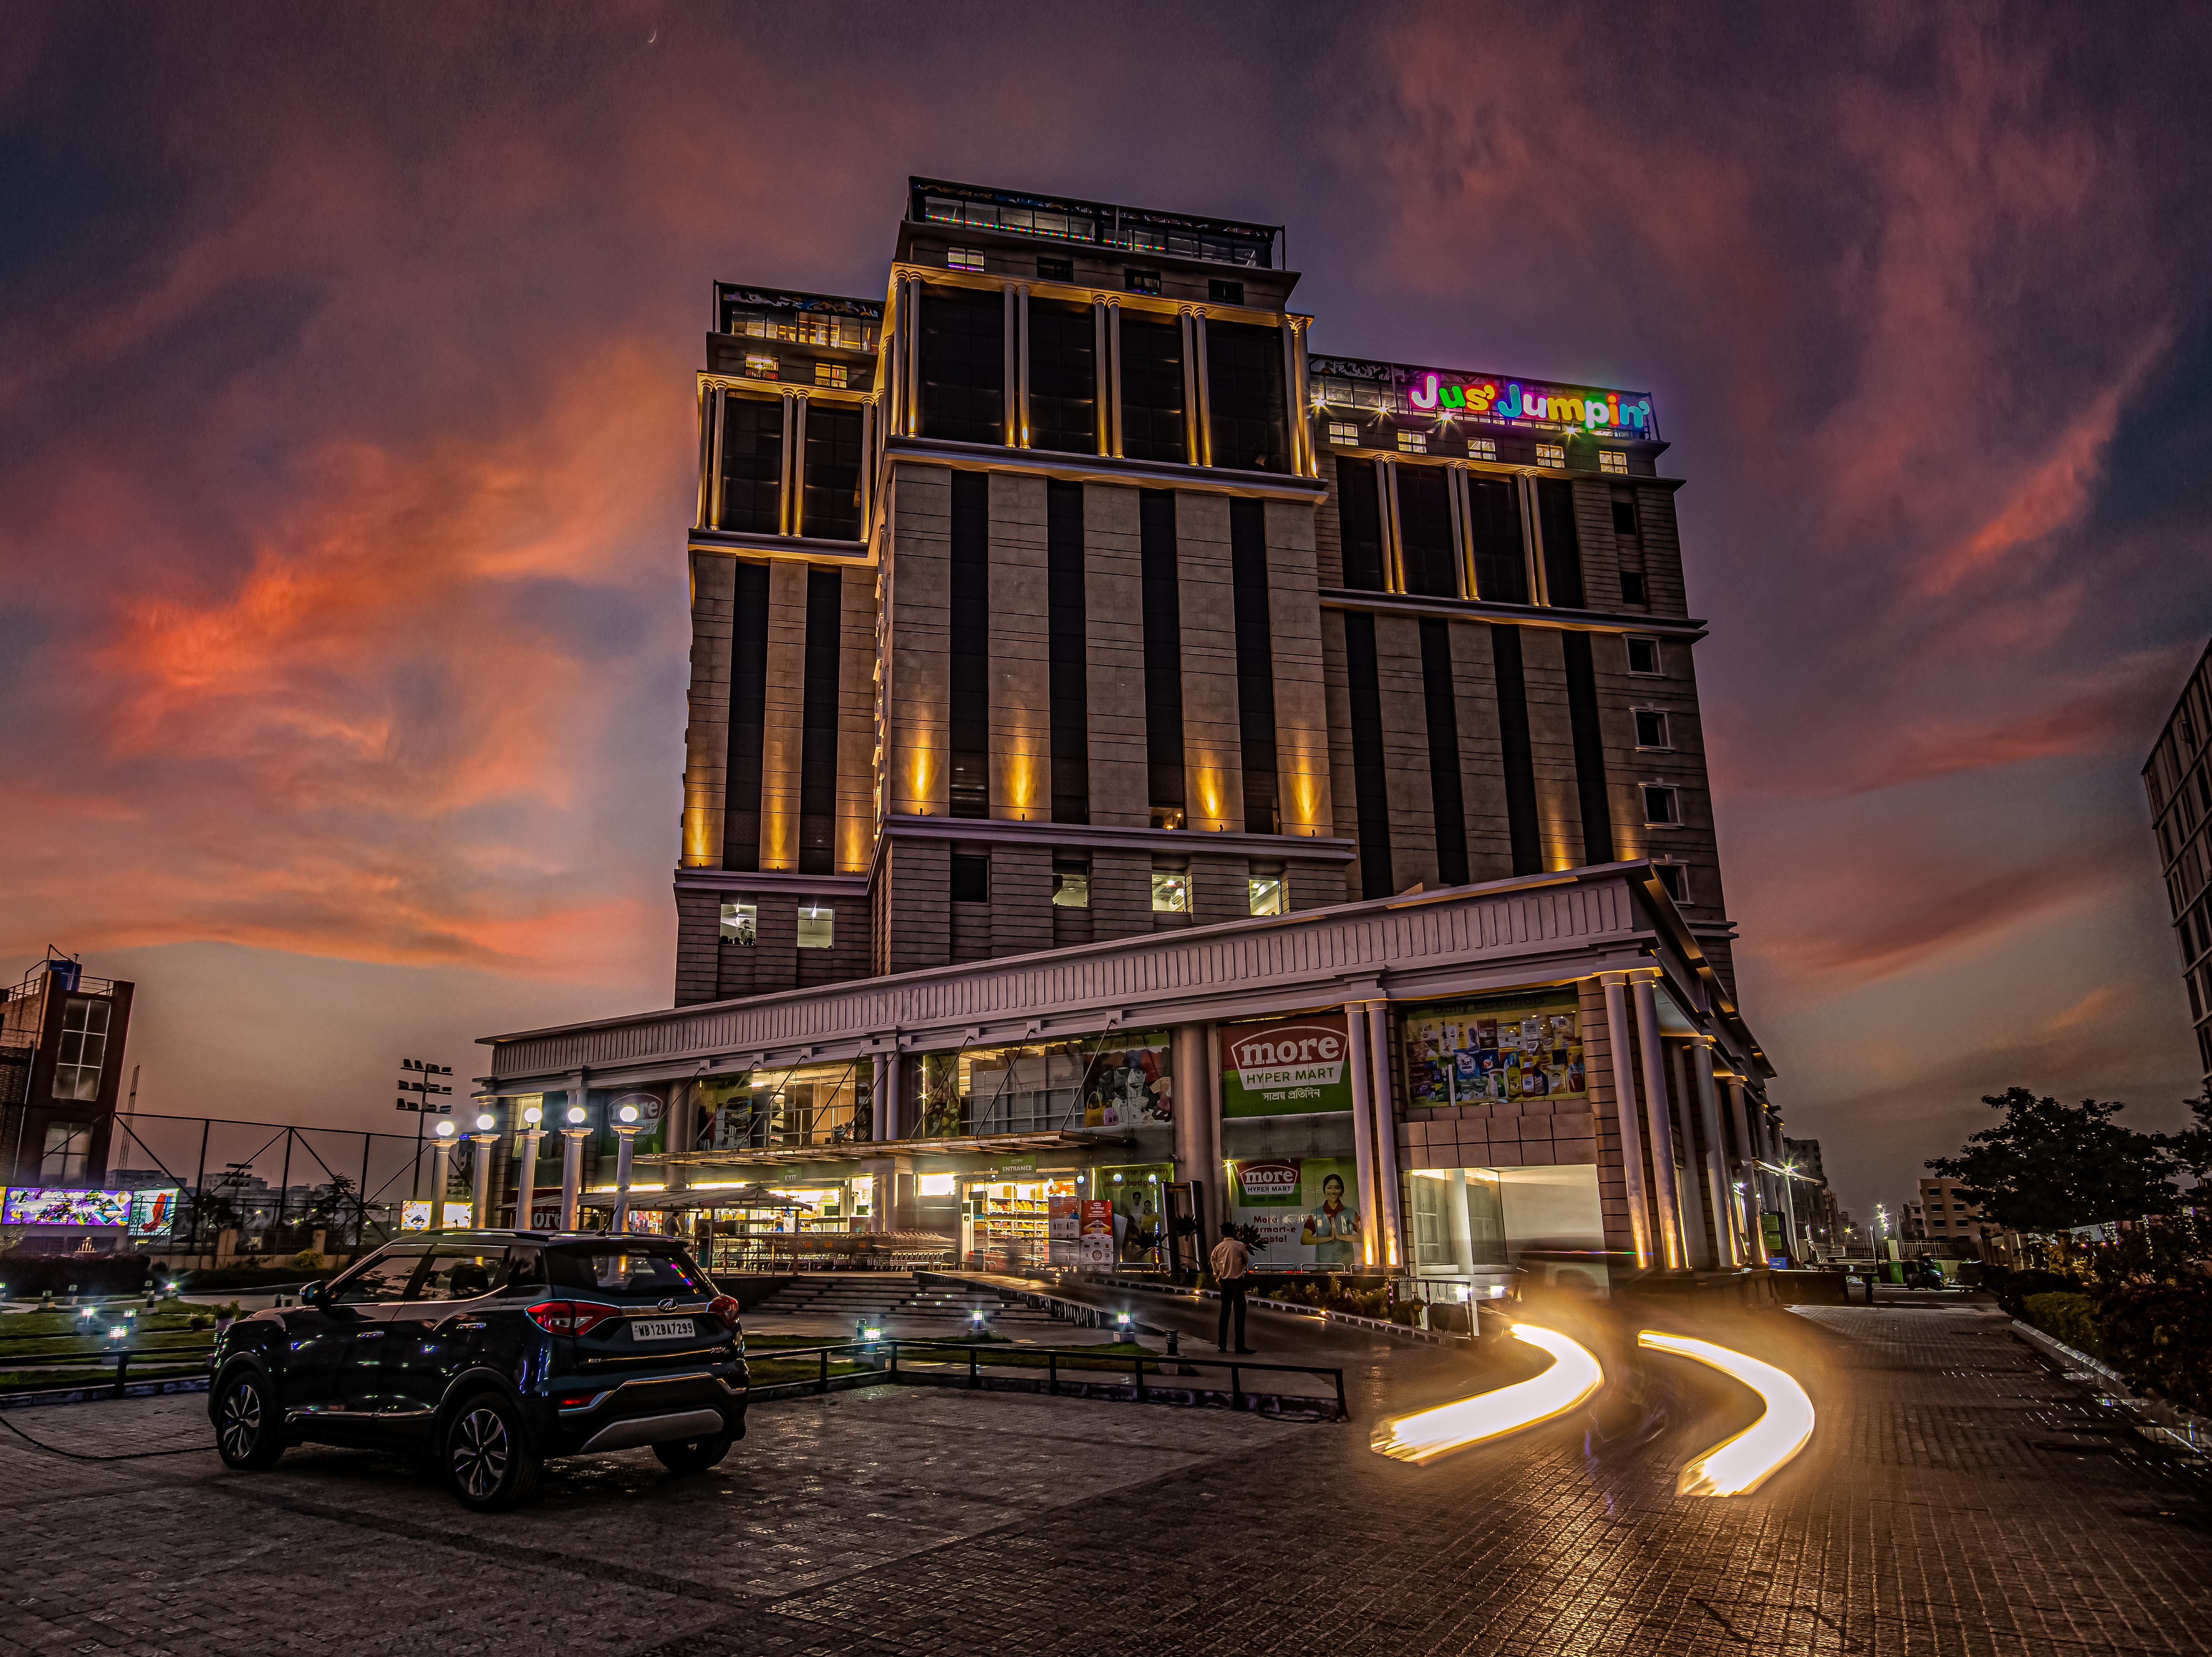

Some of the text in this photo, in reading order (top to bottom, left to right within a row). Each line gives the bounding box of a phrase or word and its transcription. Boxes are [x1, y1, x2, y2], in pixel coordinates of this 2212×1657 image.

[1242, 1037, 1339, 1066] more
[1247, 1068, 1334, 1085] HYPER MART
[612, 1101, 658, 1120] re
[1245, 1171, 1293, 1183] more
[531, 1213, 561, 1228] ore
